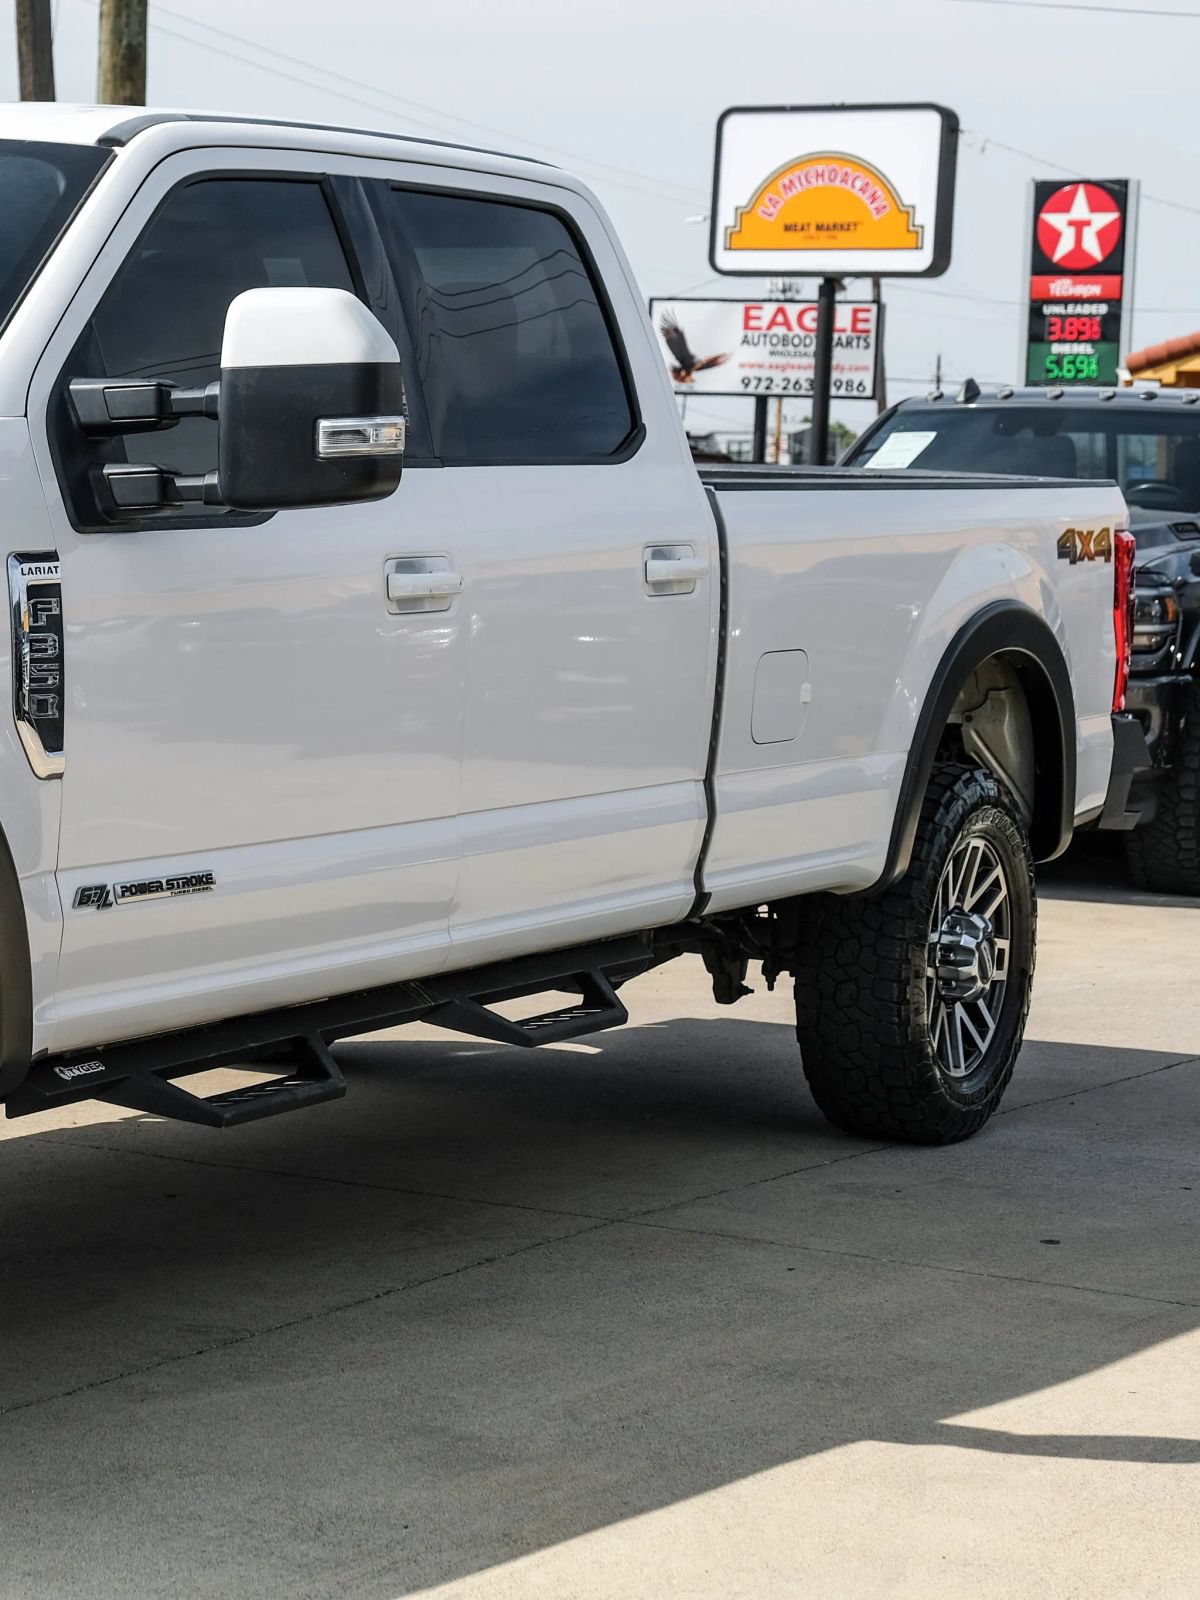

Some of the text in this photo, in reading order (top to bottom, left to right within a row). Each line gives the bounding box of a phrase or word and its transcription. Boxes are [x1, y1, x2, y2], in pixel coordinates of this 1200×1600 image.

[758, 164, 890, 221] LA MICHOACANA
[783, 222, 859, 232] MEAT MARKET
[1042, 303, 1109, 315] UNLEADED
[741, 334, 870, 349] AUTOBOD ARTS
[1051, 343, 1095, 354] DIESEL
[20, 565, 60, 576] LARIAT
[119, 881, 164, 898] POWER
[165, 872, 215, 891] STROKE
[170, 889, 191, 897] TURBO
[67, 1061, 105, 1078] TYGER
